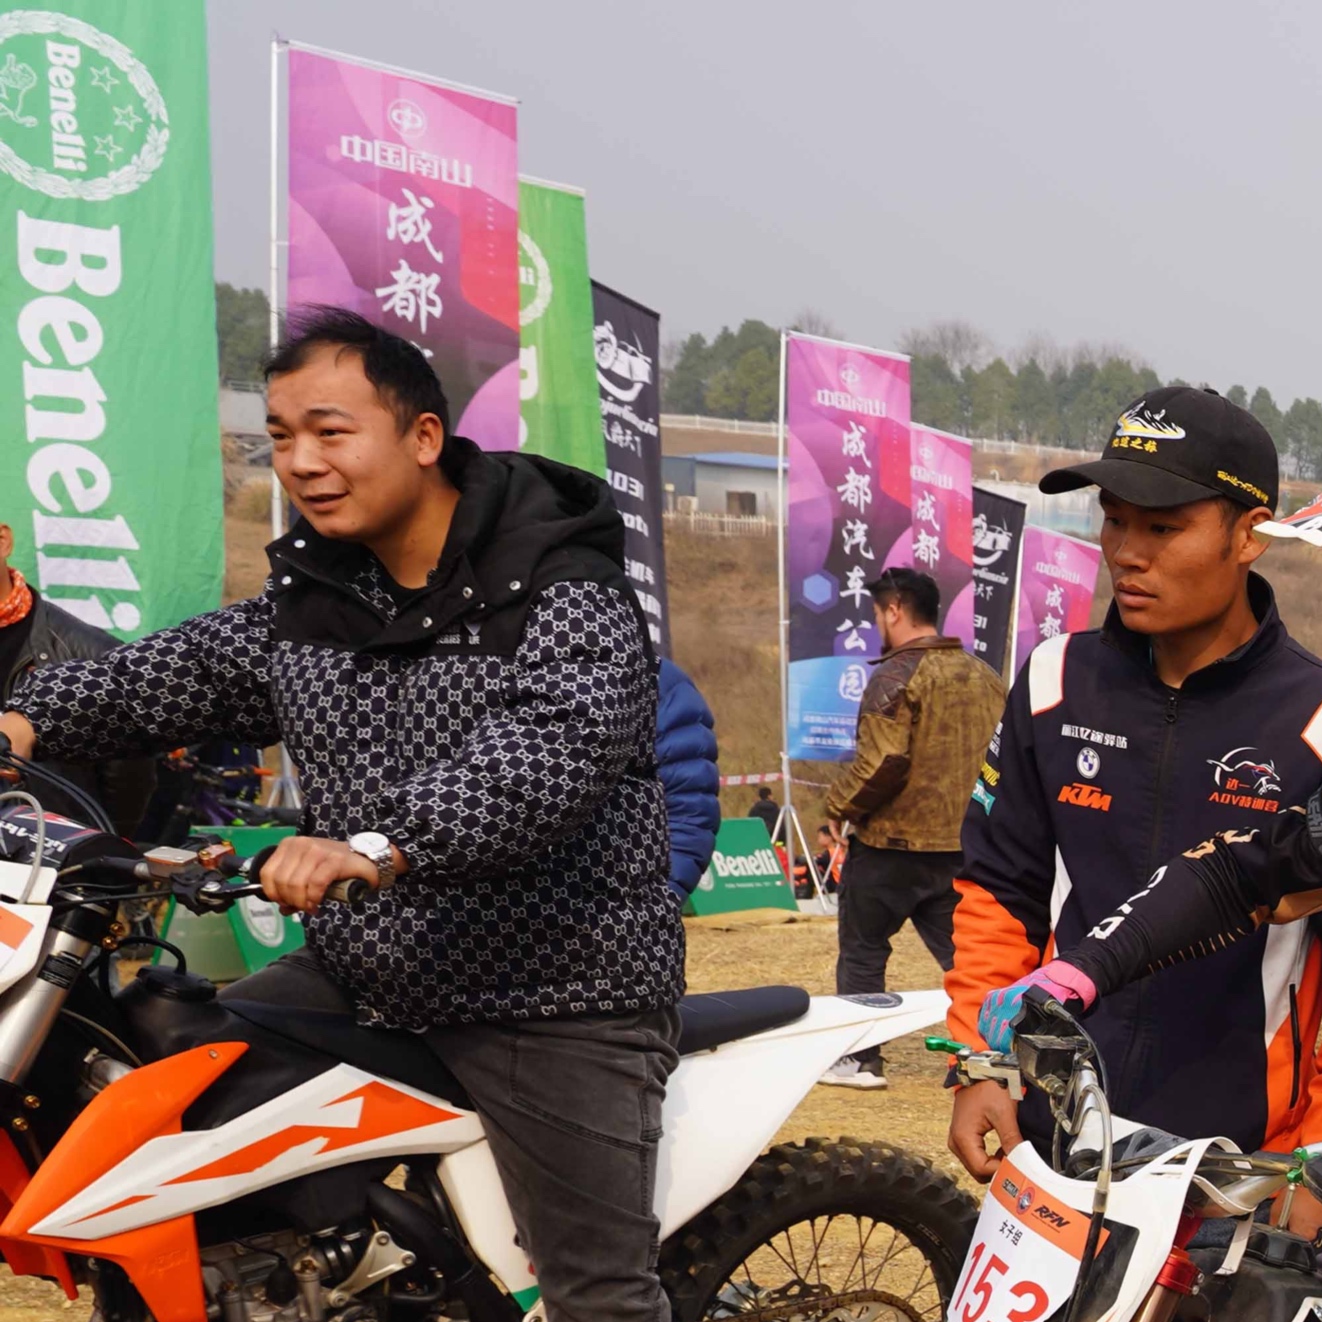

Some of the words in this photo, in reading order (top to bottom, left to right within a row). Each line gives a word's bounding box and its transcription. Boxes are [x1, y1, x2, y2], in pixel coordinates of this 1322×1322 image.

[45, 39, 87, 173] Benelli
[340, 135, 472, 188] 中国南山
[376, 187, 443, 357] 成都
[16, 209, 143, 633] Benelli
[836, 421, 875, 702] 成都汽车公园
[1057, 782, 1113, 812] KTM
[712, 848, 782, 878] Benelli
[1034, 1204, 1071, 1230] RFN
